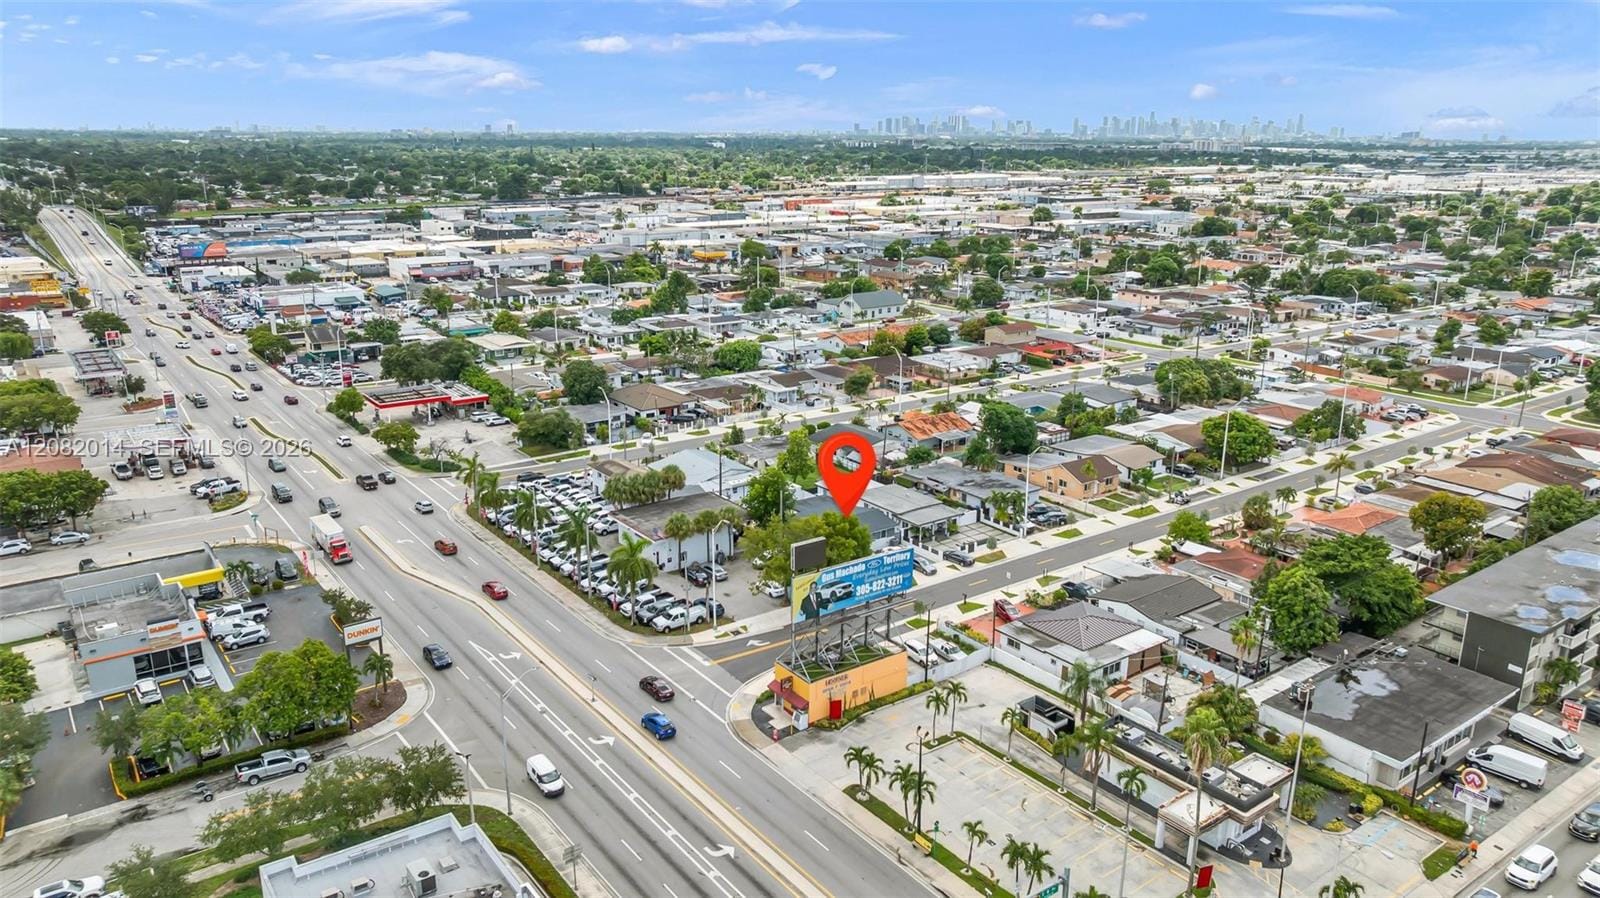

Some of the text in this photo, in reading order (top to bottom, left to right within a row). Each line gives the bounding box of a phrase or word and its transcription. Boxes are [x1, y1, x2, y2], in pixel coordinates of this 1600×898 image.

[821, 571, 835, 583] Gus
[835, 562, 866, 579] Machado
[883, 552, 911, 565] Territory
[347, 625, 380, 639] DUNKIN'
